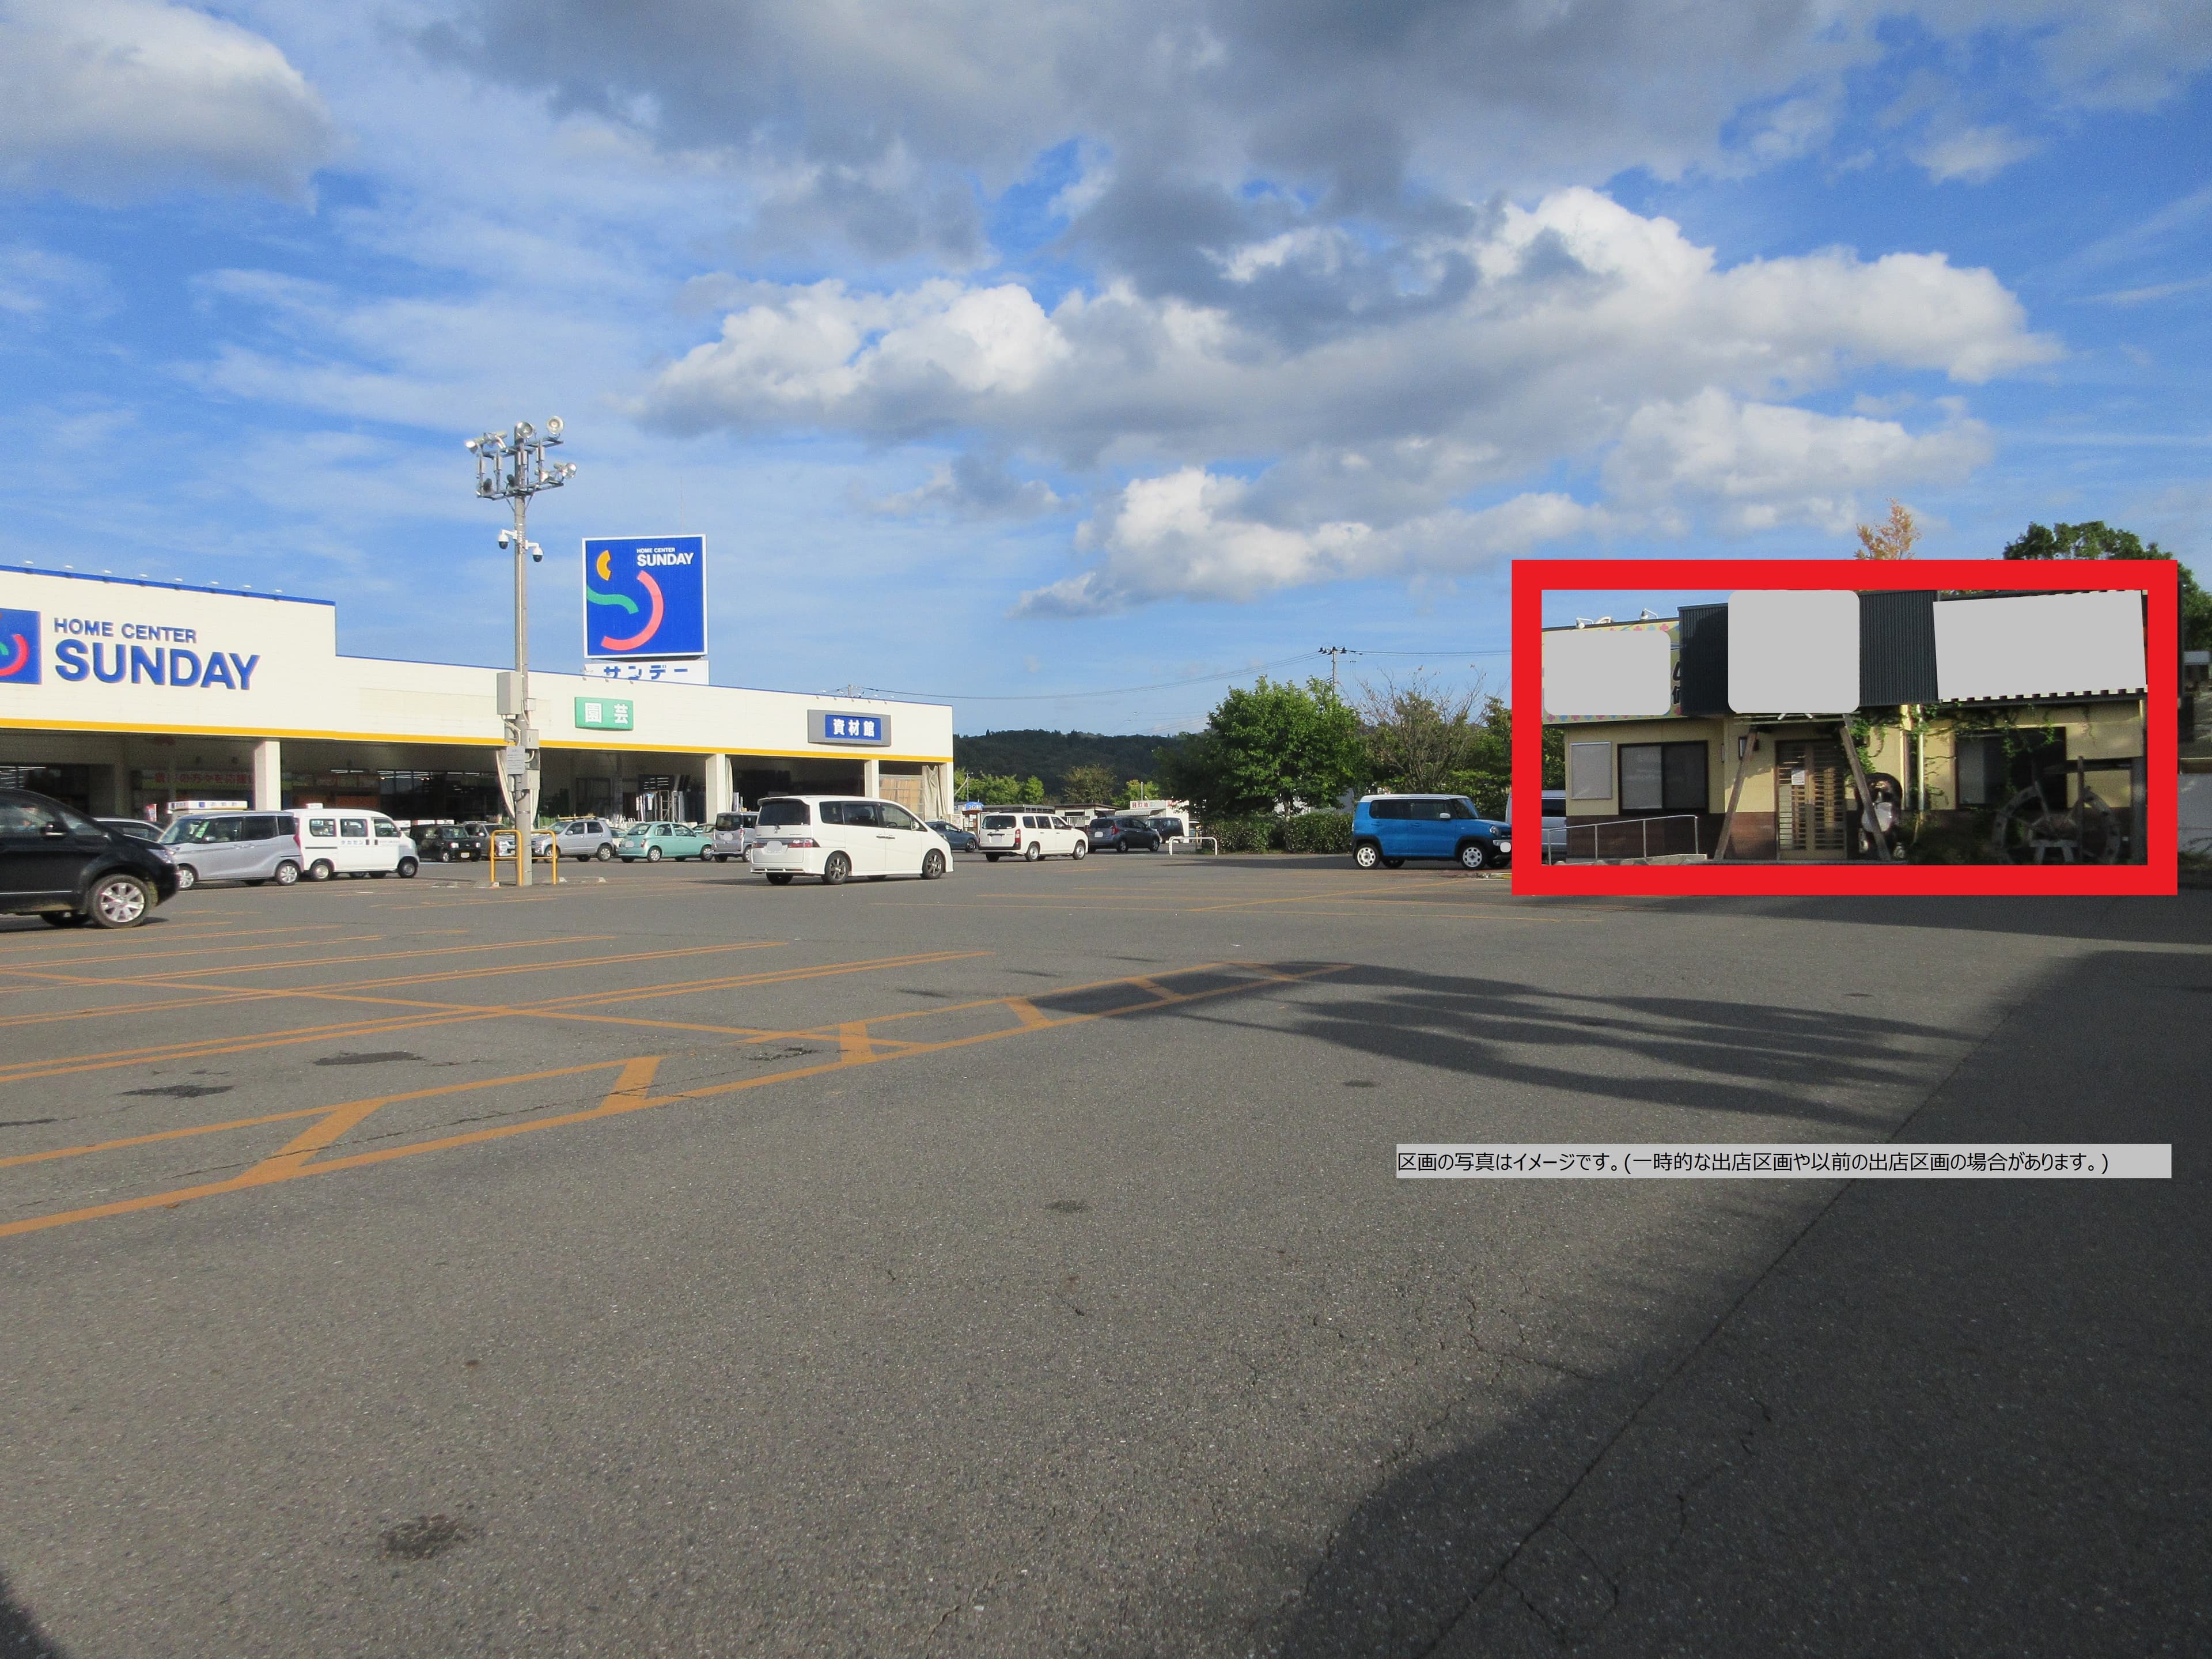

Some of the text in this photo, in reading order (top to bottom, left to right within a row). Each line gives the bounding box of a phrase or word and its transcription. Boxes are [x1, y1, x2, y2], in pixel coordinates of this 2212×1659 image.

[637, 552, 694, 567] SUNDAY
[54, 618, 197, 643] HOME CENTER
[55, 638, 261, 691] SUNDAY
[604, 665, 688, 680] サンデー
[585, 702, 628, 724] 園芸
[833, 718, 875, 737] 資材館
